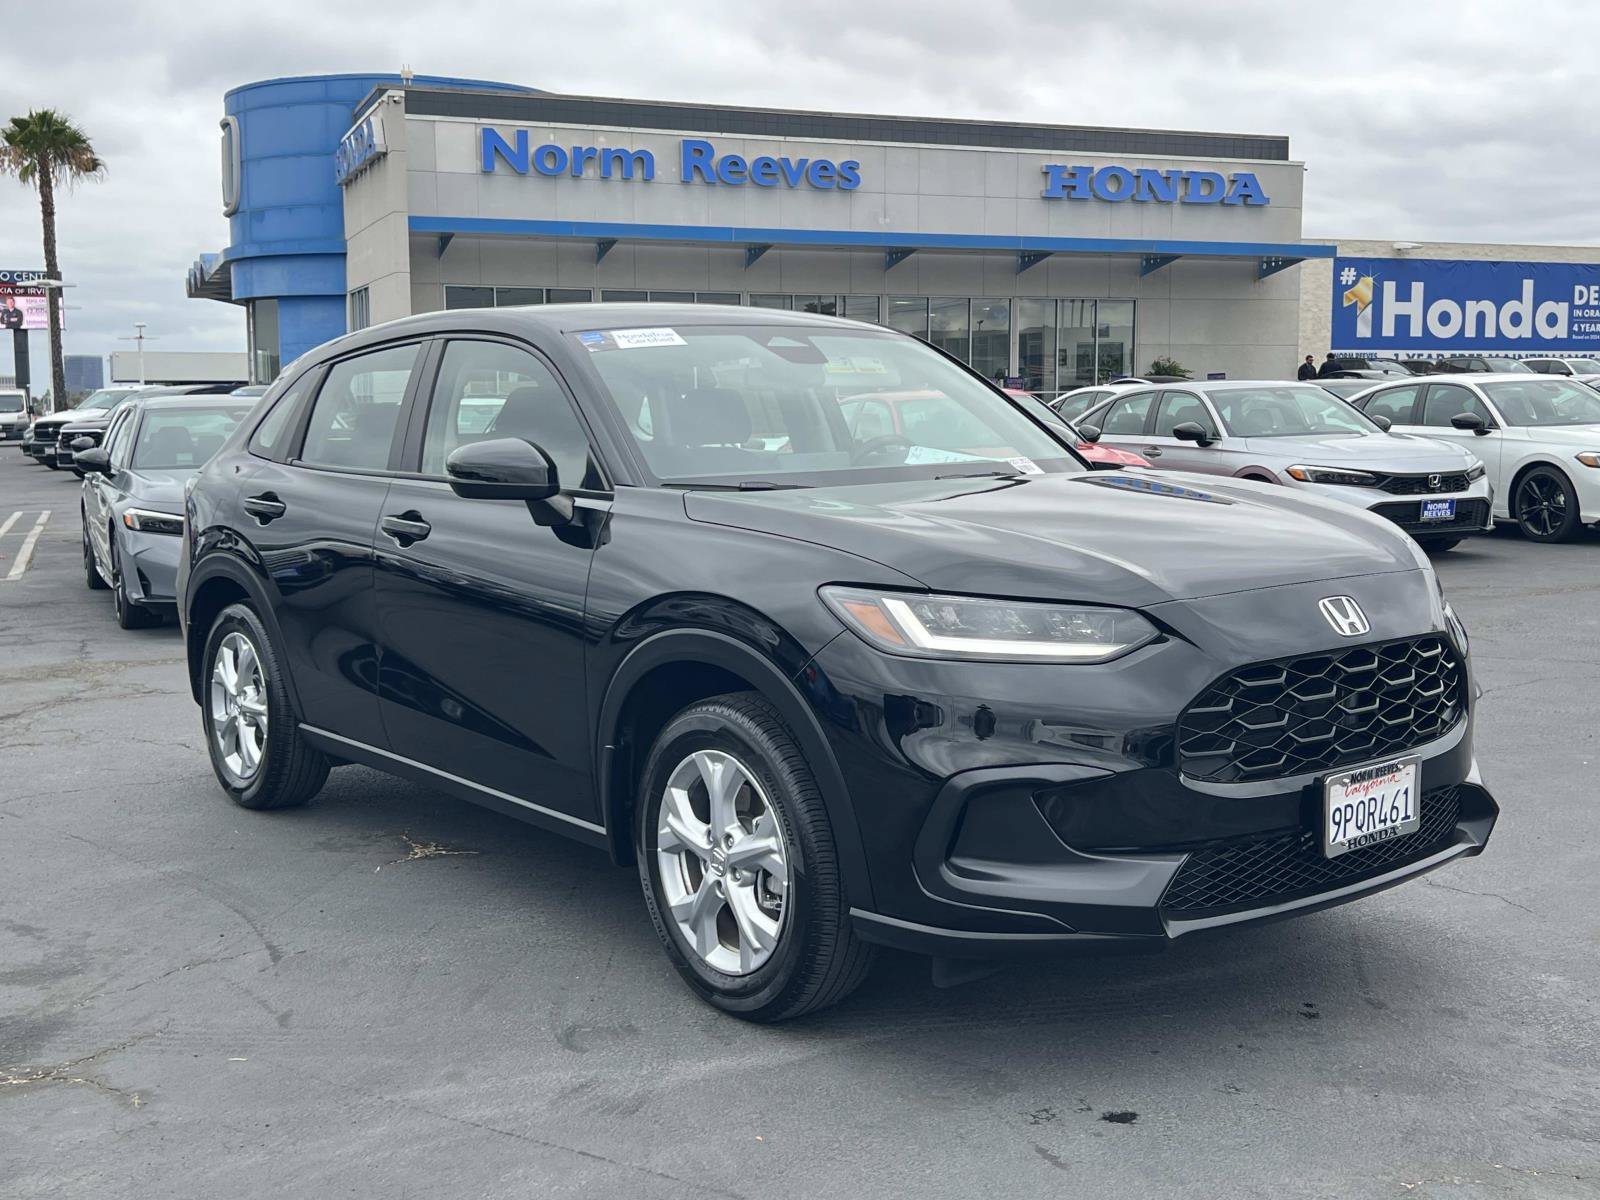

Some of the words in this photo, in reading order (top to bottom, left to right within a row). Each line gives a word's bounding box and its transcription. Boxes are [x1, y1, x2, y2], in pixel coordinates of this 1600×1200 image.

[481, 127, 655, 181] Norm
[680, 139, 861, 190] Reeves
[1040, 164, 1271, 206] HONDA
[14, 272, 47, 281] CENT
[28, 287, 45, 295] IRVI
[1573, 285, 1600, 306] DE
[1382, 279, 1569, 339] Honda
[1572, 323, 1578, 332] 4
[1424, 509, 1451, 518] REEVES
[1427, 502, 1449, 511] NORM
[1344, 774, 1400, 797] California
[1332, 786, 1411, 843] 9PQR461
[1347, 826, 1398, 850] HONDA
